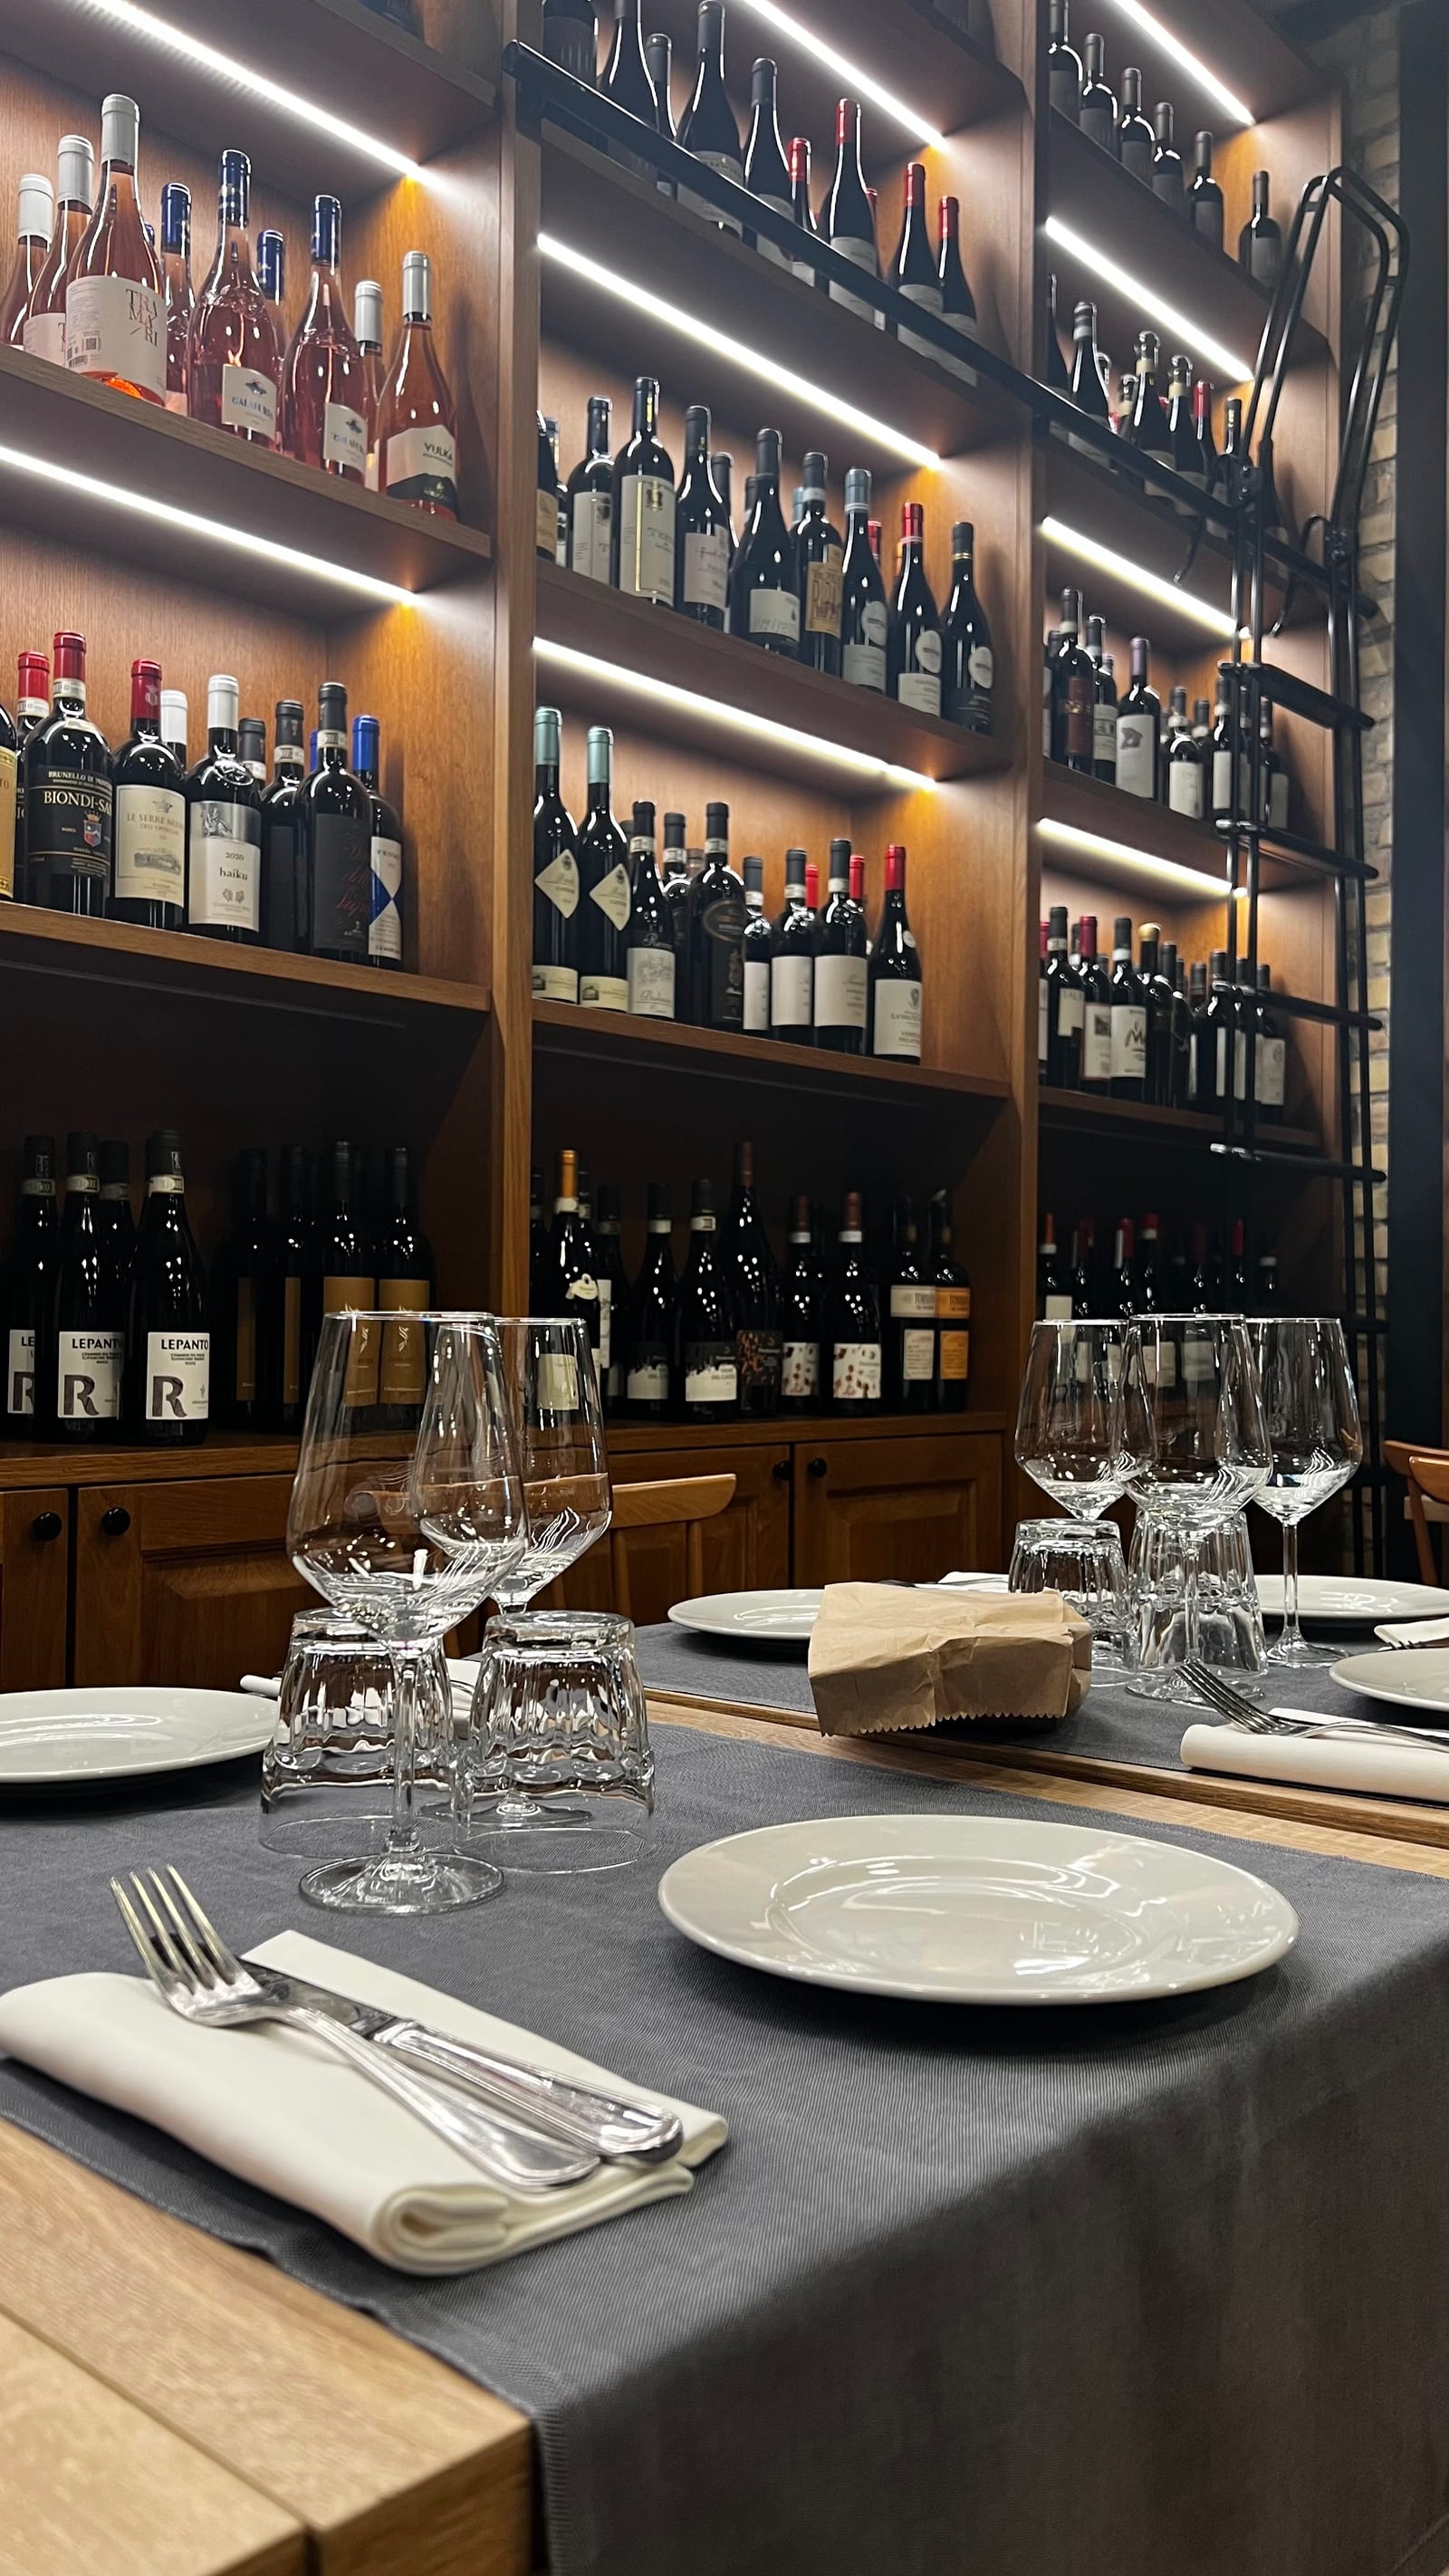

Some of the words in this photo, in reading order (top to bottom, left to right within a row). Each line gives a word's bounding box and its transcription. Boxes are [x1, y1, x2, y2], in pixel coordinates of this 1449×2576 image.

[225, 851, 245, 861] 2020
[219, 867, 248, 880] haiku
[161, 1339, 209, 1350] LEPANTO
[64, 1374, 100, 1416] R
[152, 1375, 187, 1417] R
